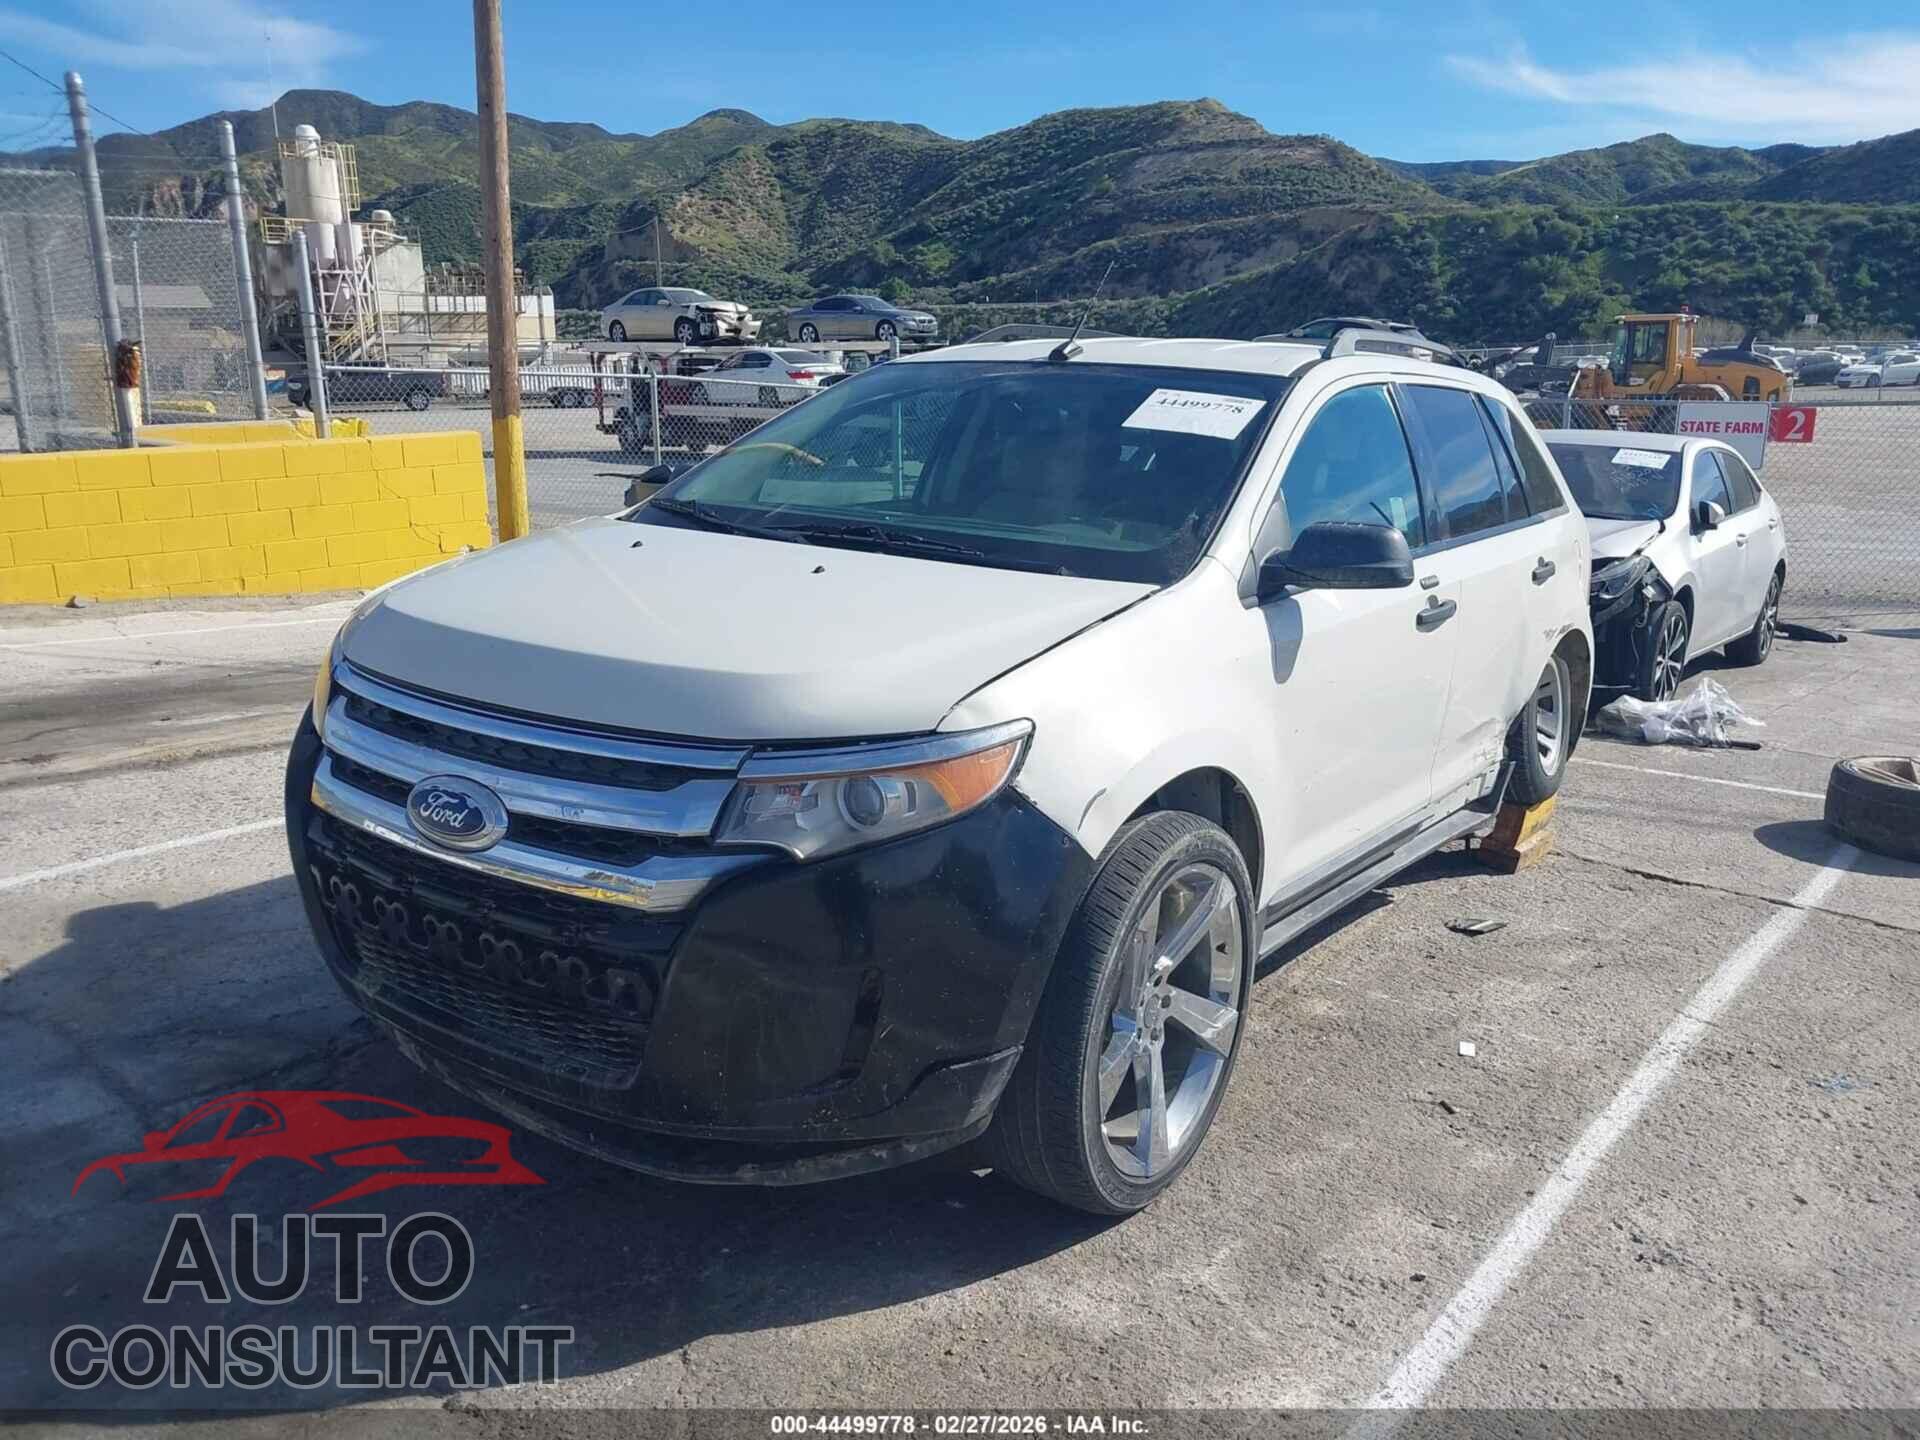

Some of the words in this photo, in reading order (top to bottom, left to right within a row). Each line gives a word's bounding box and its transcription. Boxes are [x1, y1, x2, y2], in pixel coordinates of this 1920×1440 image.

[1156, 398, 1244, 414] 44499778
[1680, 420, 1720, 433] STATE
[1724, 421, 1764, 434] FARM
[1785, 410, 1806, 440] 2
[420, 791, 469, 828] Ford
